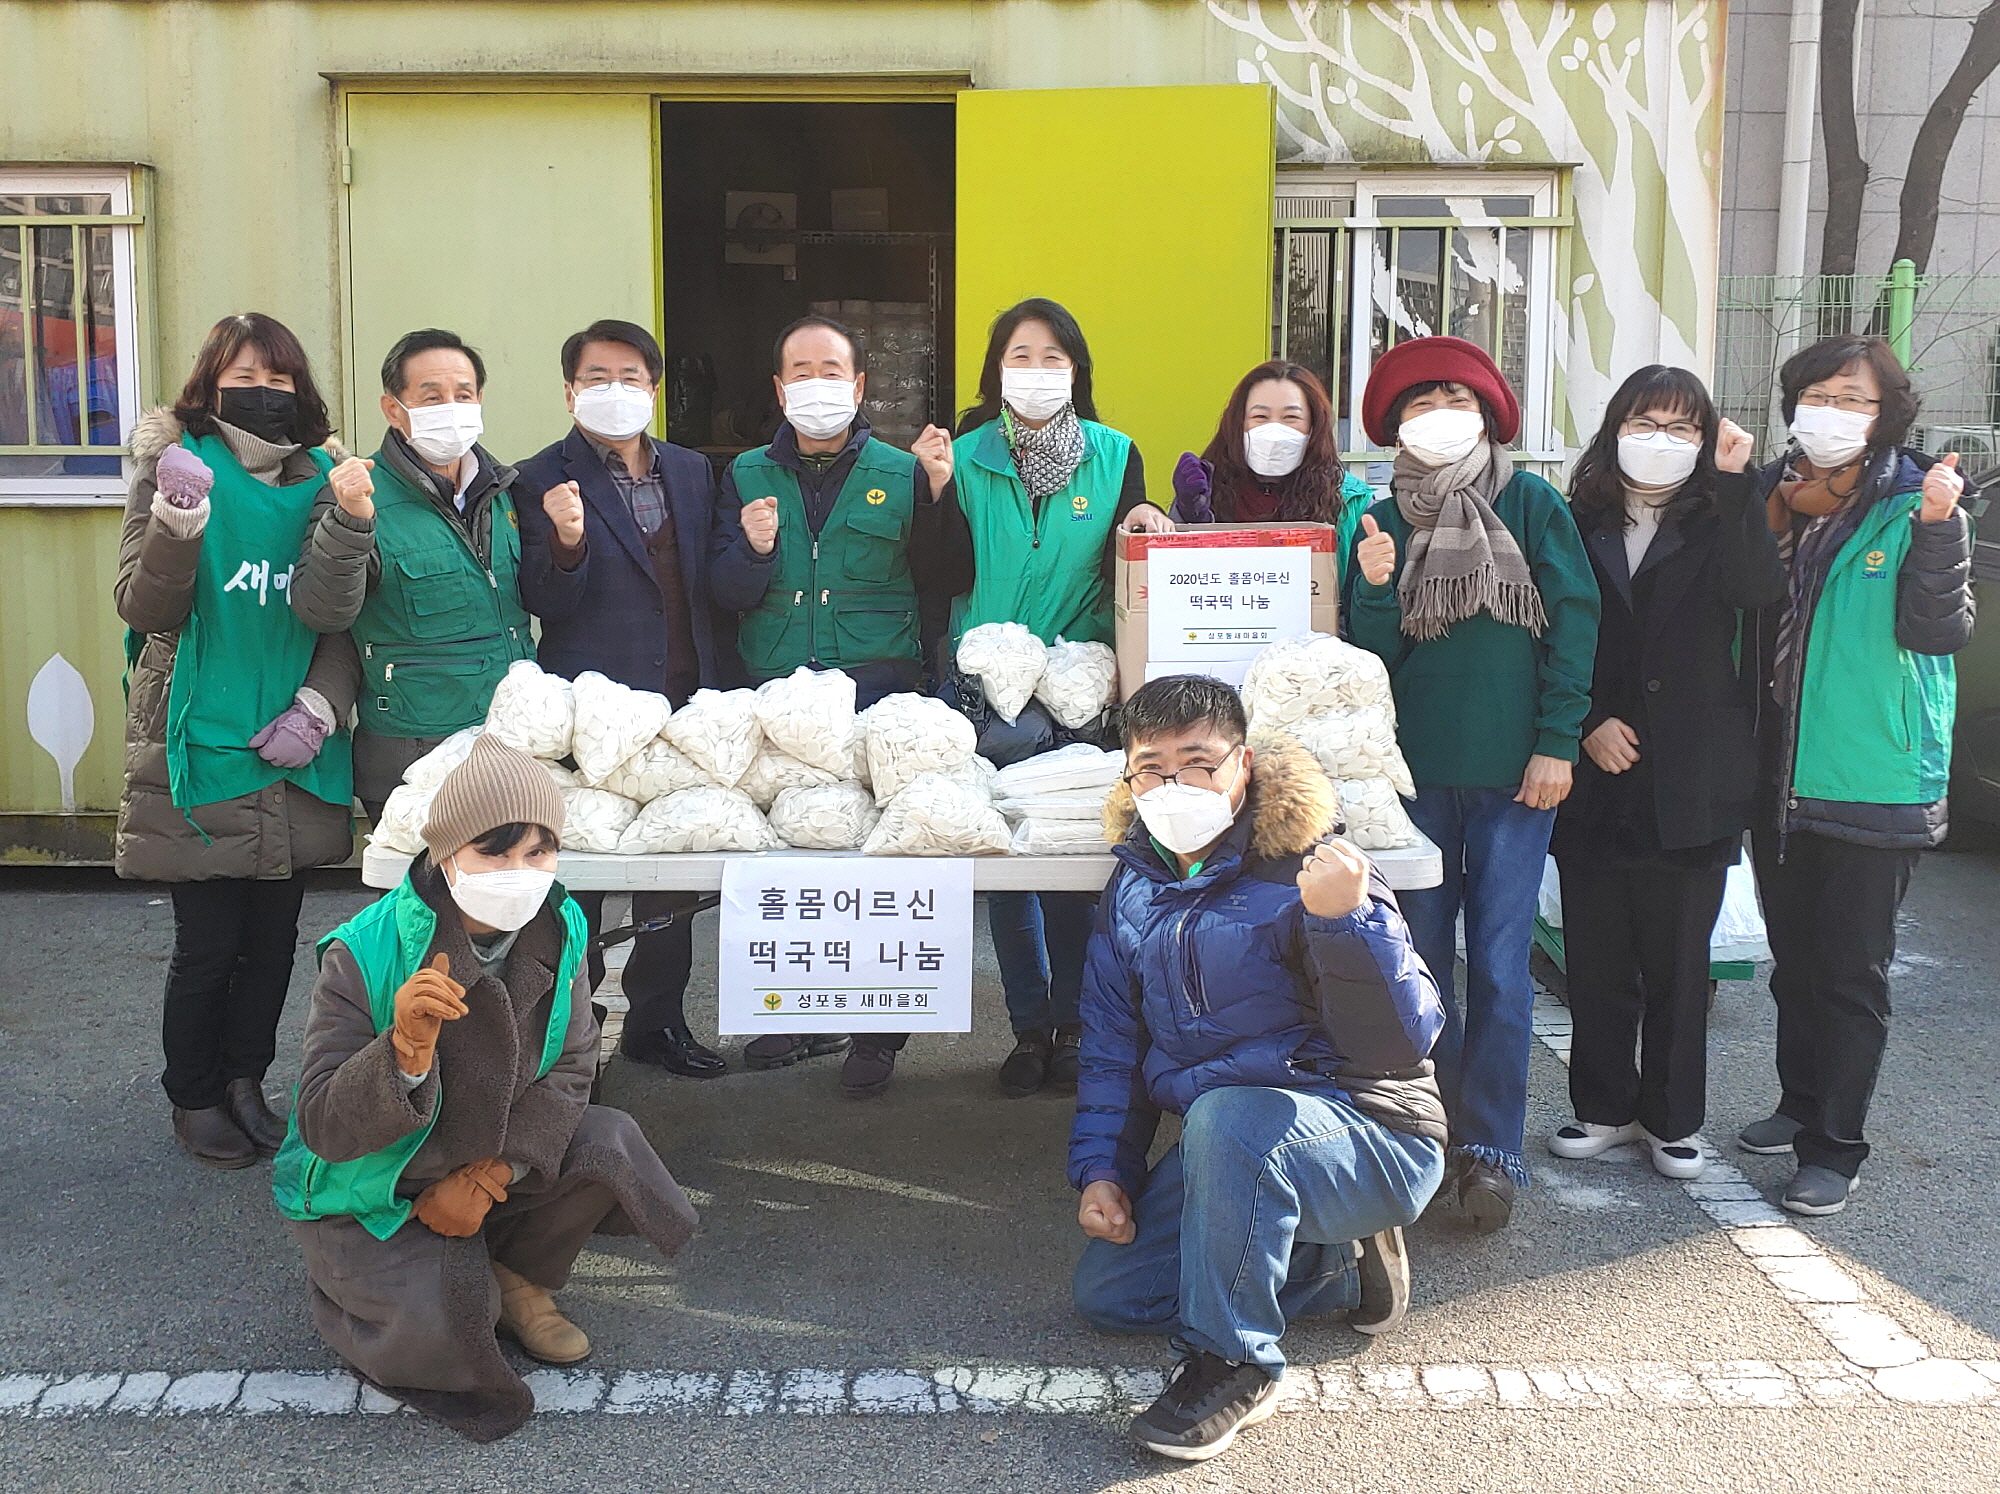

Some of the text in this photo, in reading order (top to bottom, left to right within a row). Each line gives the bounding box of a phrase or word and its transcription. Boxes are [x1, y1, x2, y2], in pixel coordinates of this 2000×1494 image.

[1071, 513, 1093, 521] SMU
[1170, 572, 1289, 585] 2020년도 홀몸어르신
[1190, 595, 1270, 610] 떡국떡 나눔
[758, 887, 933, 920] 홀몸어르신
[750, 941, 944, 972] 떡국떡 나눔
[798, 994, 927, 1008] 성포동 새마을회
